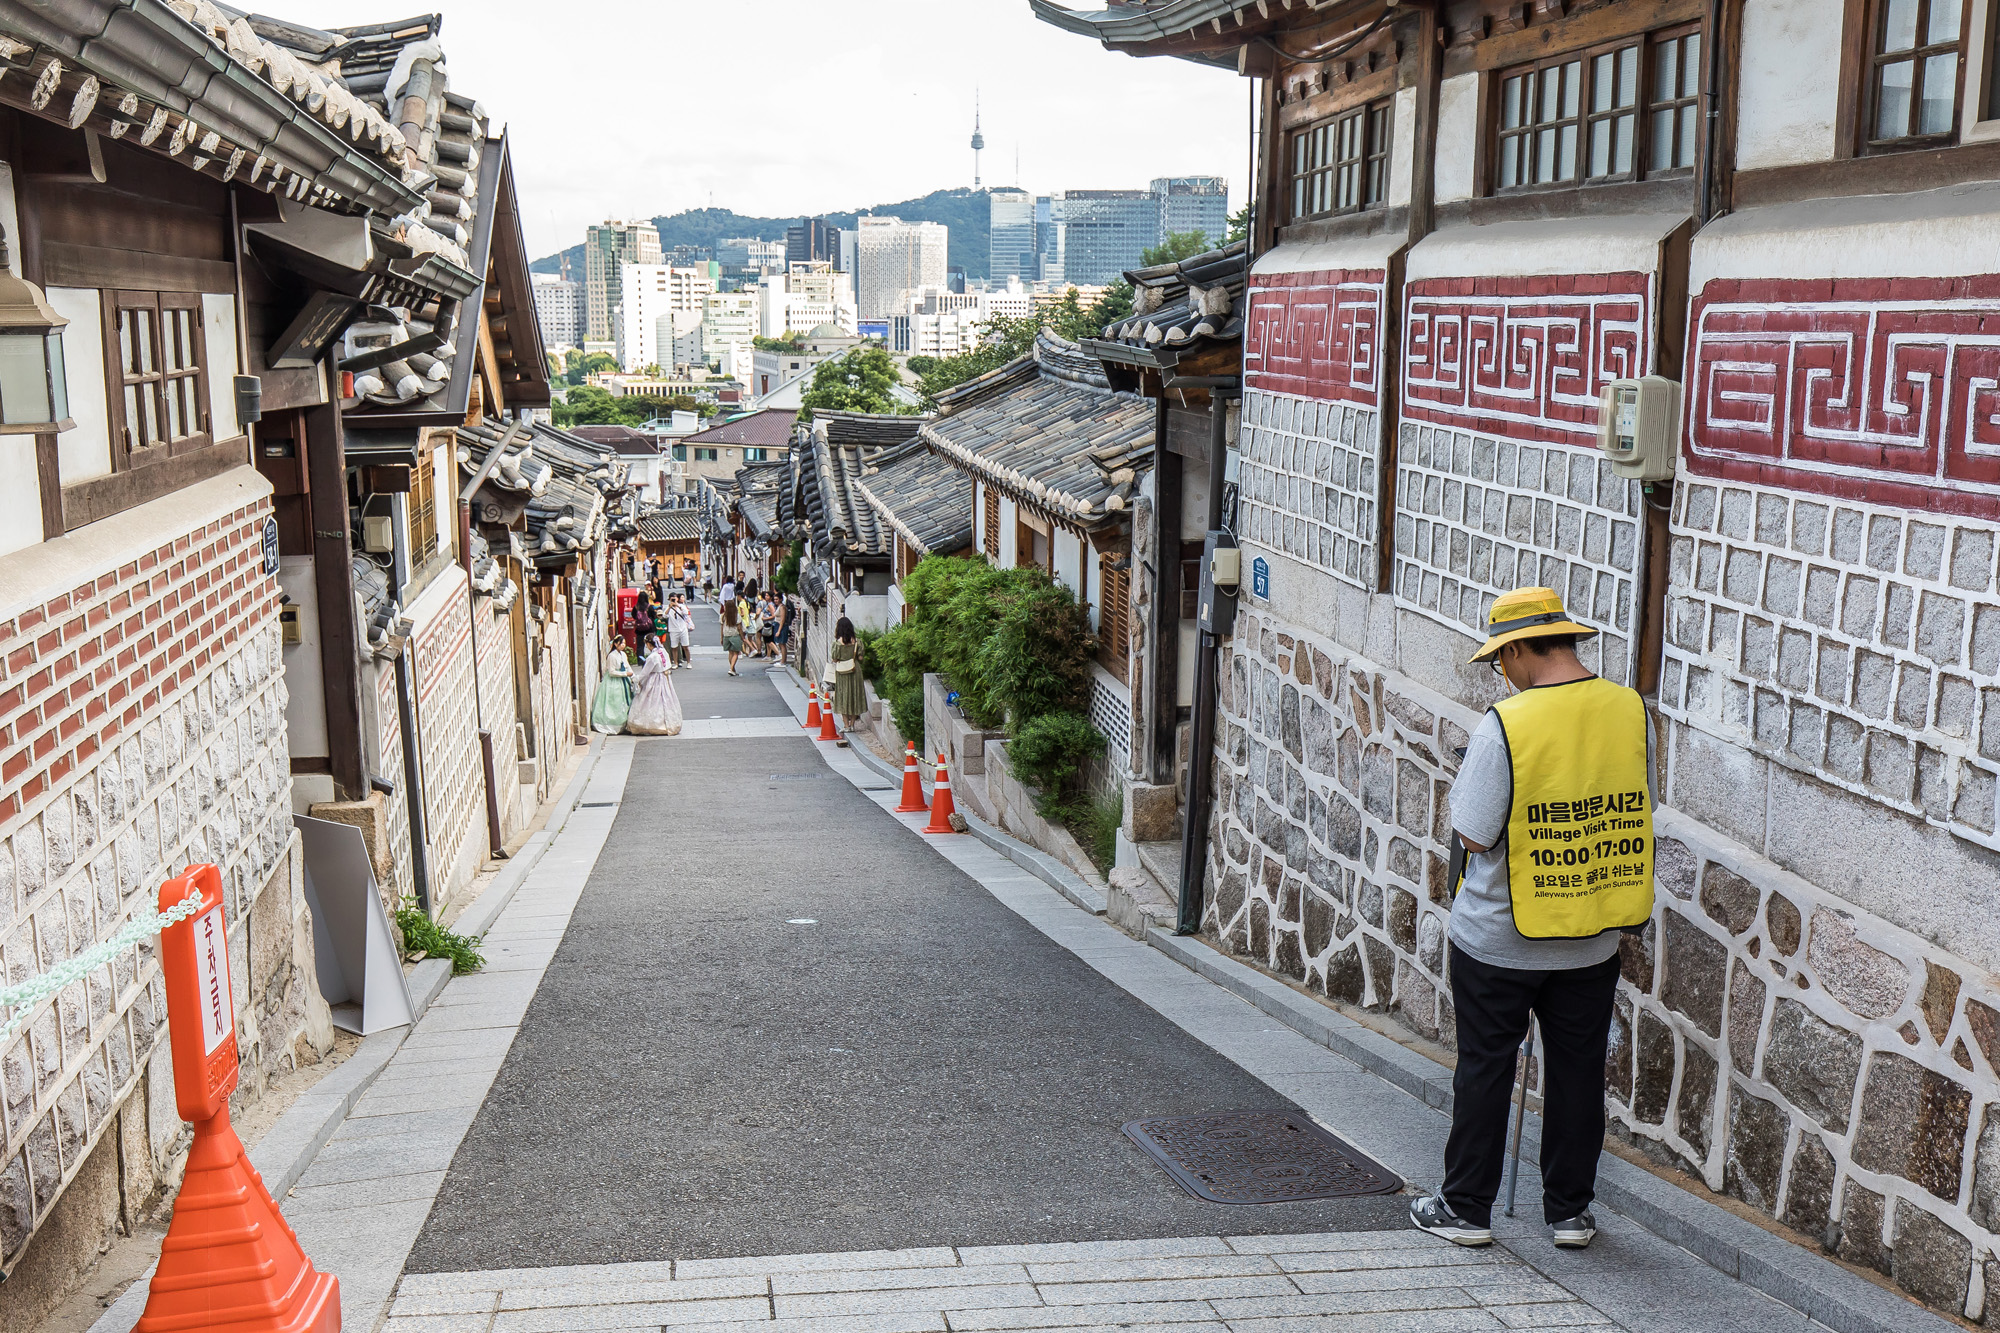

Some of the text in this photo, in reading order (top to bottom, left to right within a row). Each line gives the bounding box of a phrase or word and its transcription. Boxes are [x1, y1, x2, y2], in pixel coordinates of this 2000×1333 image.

[267, 543, 278, 569] 58-1
[1257, 576, 1265, 594] 57
[1527, 791, 1644, 823] 마을방문시간
[1529, 817, 1644, 842] Village Visit Time
[1533, 874, 1583, 887] 일요일은
[1612, 862, 1644, 877] 쉬는날
[1534, 891, 1574, 899] Alleyways
[1612, 879, 1644, 887] Sundays
[204, 915, 224, 1036] 주차금지
